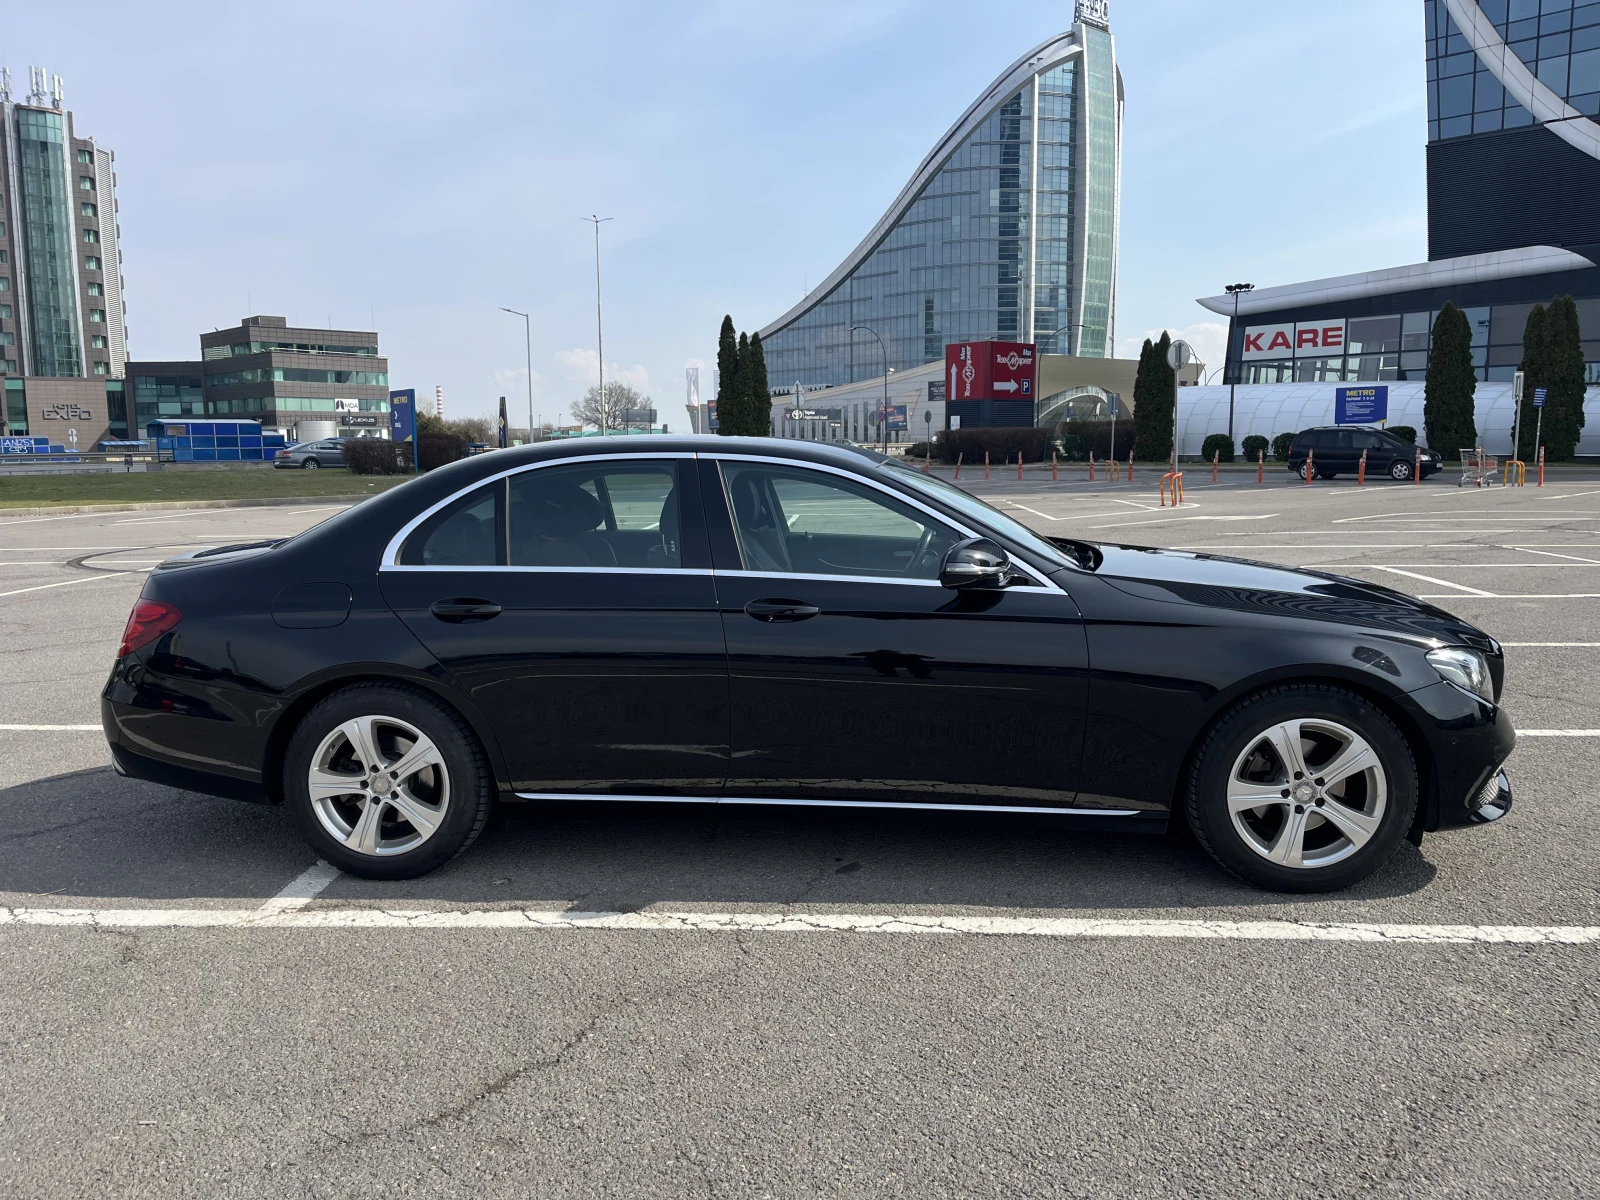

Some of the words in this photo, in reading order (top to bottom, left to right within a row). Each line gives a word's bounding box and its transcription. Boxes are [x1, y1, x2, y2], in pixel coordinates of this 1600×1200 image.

[1244, 326, 1343, 352] KARE
[1023, 381, 1029, 391] P
[1346, 389, 1375, 397] METRO
[42, 409, 92, 420] EXPO
